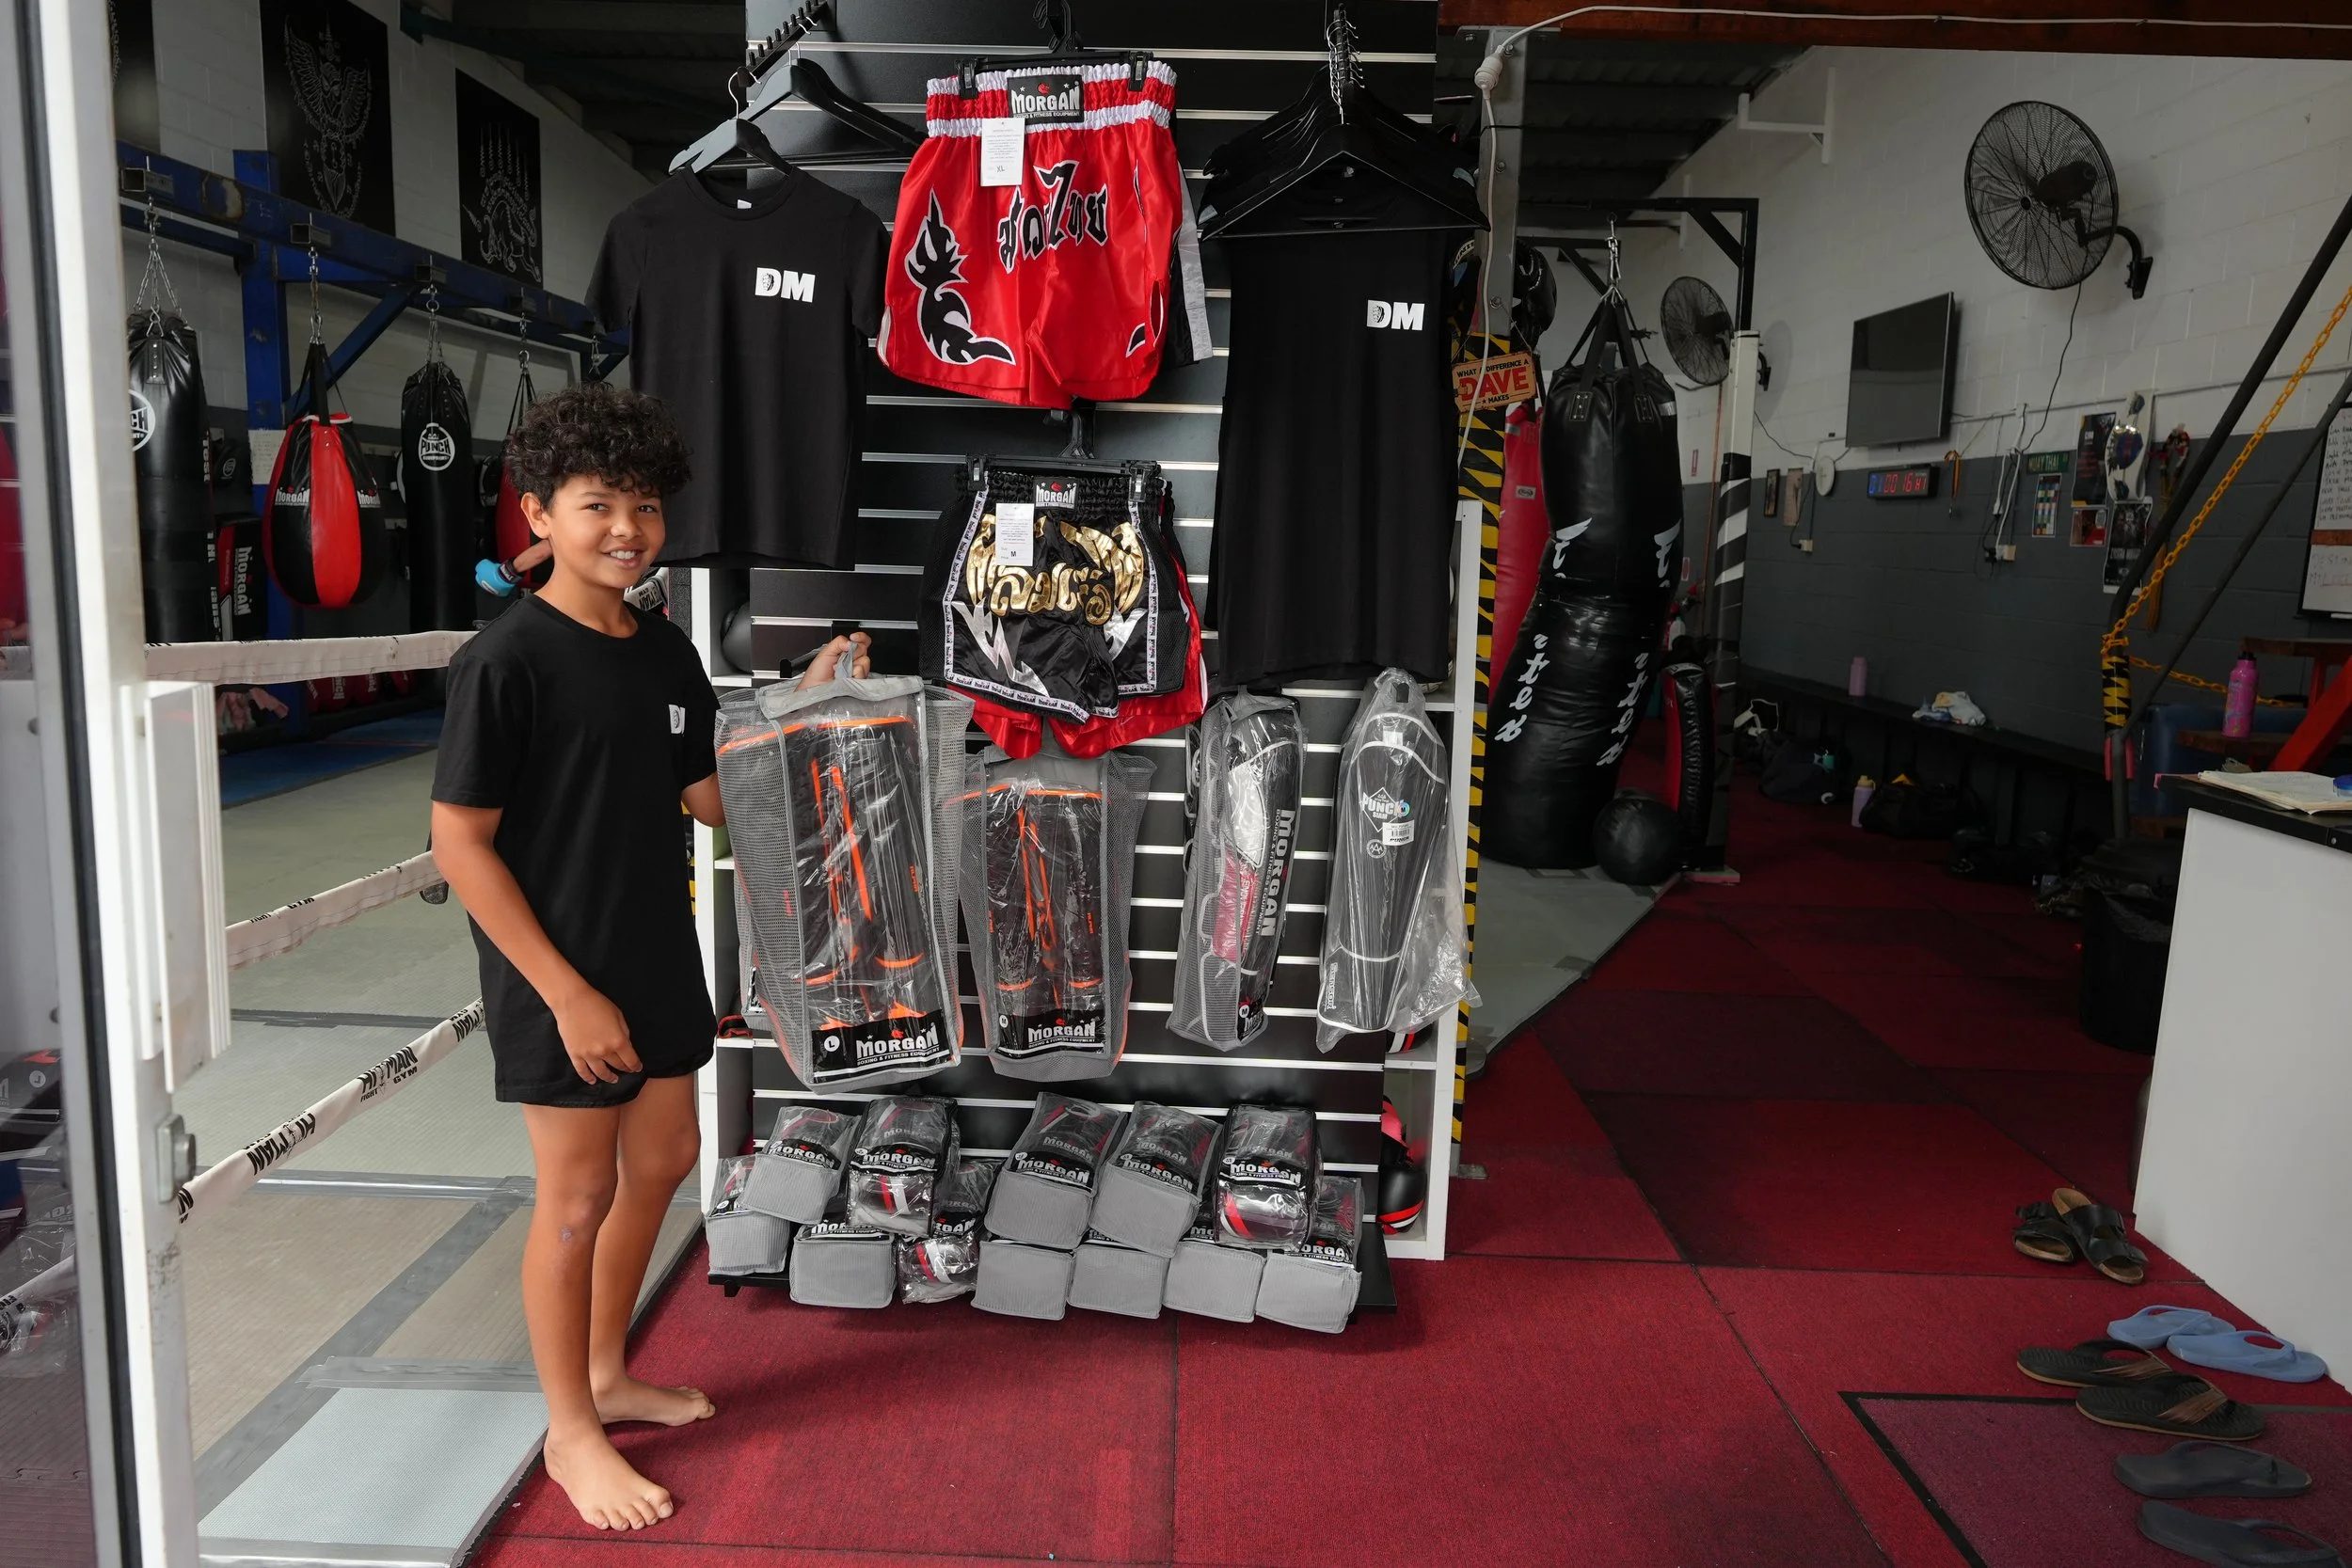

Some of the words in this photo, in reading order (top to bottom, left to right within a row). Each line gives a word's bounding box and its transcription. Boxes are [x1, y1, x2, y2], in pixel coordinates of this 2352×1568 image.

[1011, 86, 1080, 114] MORGAN
[755, 267, 816, 303] DM
[1367, 299, 1425, 331] DM
[1457, 368, 1477, 378] WHAT
[1486, 359, 1522, 372] DIFFERENCE
[1459, 366, 1530, 402] DAVE
[1488, 393, 1510, 404] MAKES
[421, 438, 452, 456] PUNCH
[1036, 484, 1077, 504] MORGAN
[237, 546, 253, 616] MORGAN
[668, 704, 686, 734] D
[1272, 809, 1280, 842] BOXING
[1372, 811, 1389, 820] SIAM
[1260, 809, 1296, 937] MORGAN
[1264, 850, 1276, 886] FITNESS
[1256, 887, 1268, 935] EQUIPMENT
[856, 1023, 939, 1059] MORGAN
[1028, 1021, 1096, 1043] MORGAN
[828, 1039, 835, 1049] L
[857, 1057, 879, 1067] BOXING
[884, 1052, 909, 1060] FITNESS
[910, 1046, 941, 1057] EQUIPMENT
[392, 1065, 418, 1085] GYM
[359, 1087, 378, 1103] FIGHT
[770, 1146, 834, 1168] MORGAN
[863, 1152, 935, 1166] MORGAN
[1042, 1136, 1092, 1164] MORGAN
[1017, 1159, 1090, 1183] MORGAN
[1123, 1159, 1194, 1190] MORGAN
[1231, 1163, 1302, 1186] MORGAN
[934, 1219, 976, 1233] RGAN
